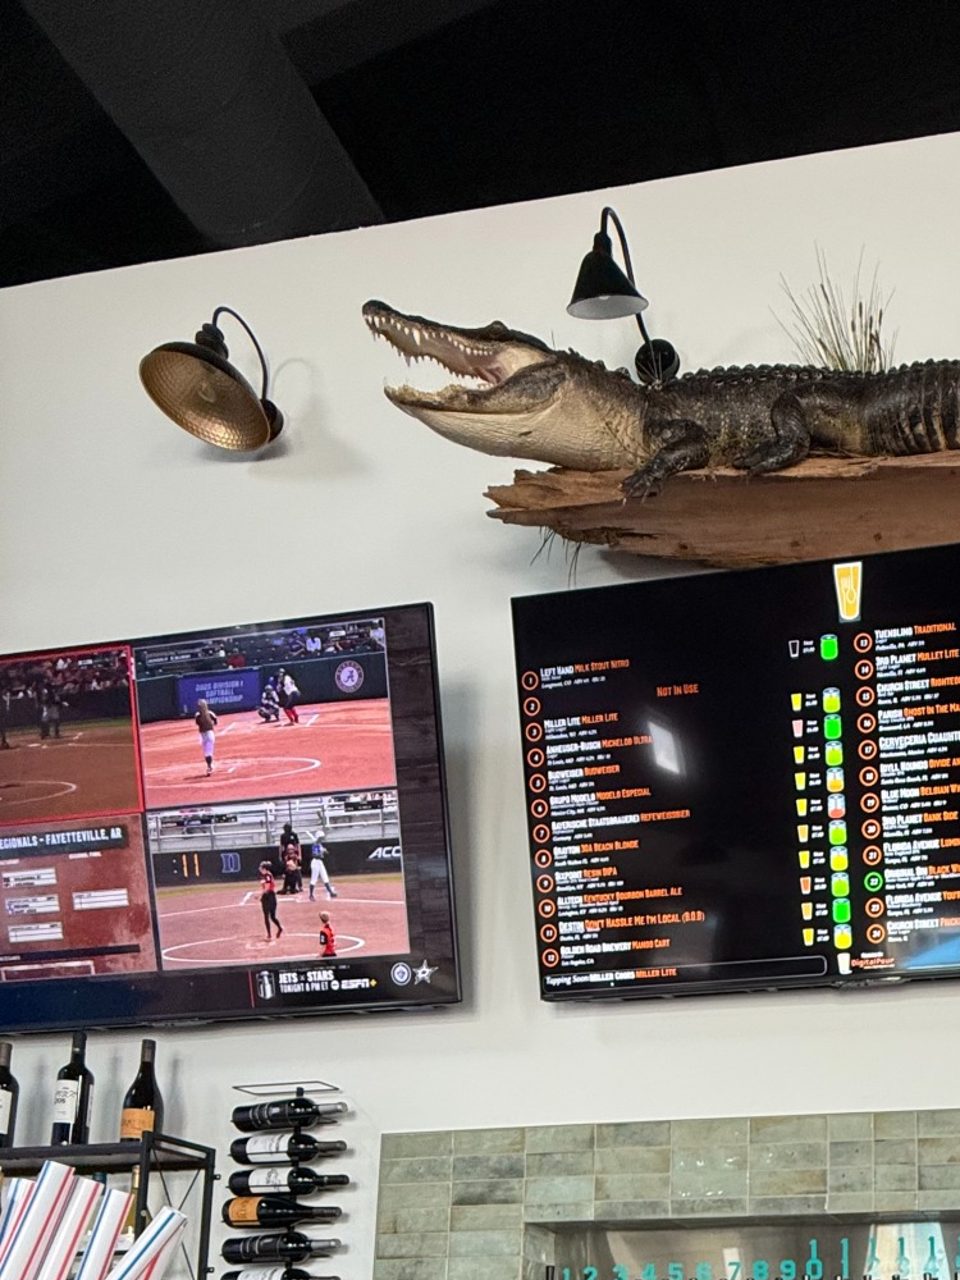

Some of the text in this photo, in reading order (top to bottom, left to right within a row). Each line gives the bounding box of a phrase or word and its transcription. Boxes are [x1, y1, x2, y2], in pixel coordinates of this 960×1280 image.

[890, 648, 960, 664] PLANET MULLET LITE
[540, 659, 630, 677] LEFT HAND MILK STOUT NITRO
[656, 683, 699, 697] NOT IN USE
[903, 706, 926, 718] GHOST
[935, 703, 949, 715] THE
[544, 712, 618, 729] MILLER LITE MILLER LITE
[45, 828, 109, 846] FAYETTEVILLE,
[110, 827, 123, 839] AR
[670, 886, 682, 896] ALE
[606, 916, 632, 928] HASSLE
[634, 915, 645, 925] ME
[657, 913, 680, 923] LOCAL
[279, 970, 335, 984] JETS STARS
[546, 974, 572, 986] Tapping
[280, 981, 304, 994] TONIGHT
[728, 1261, 742, 1280] 7
[780, 1259, 796, 1280] 9
